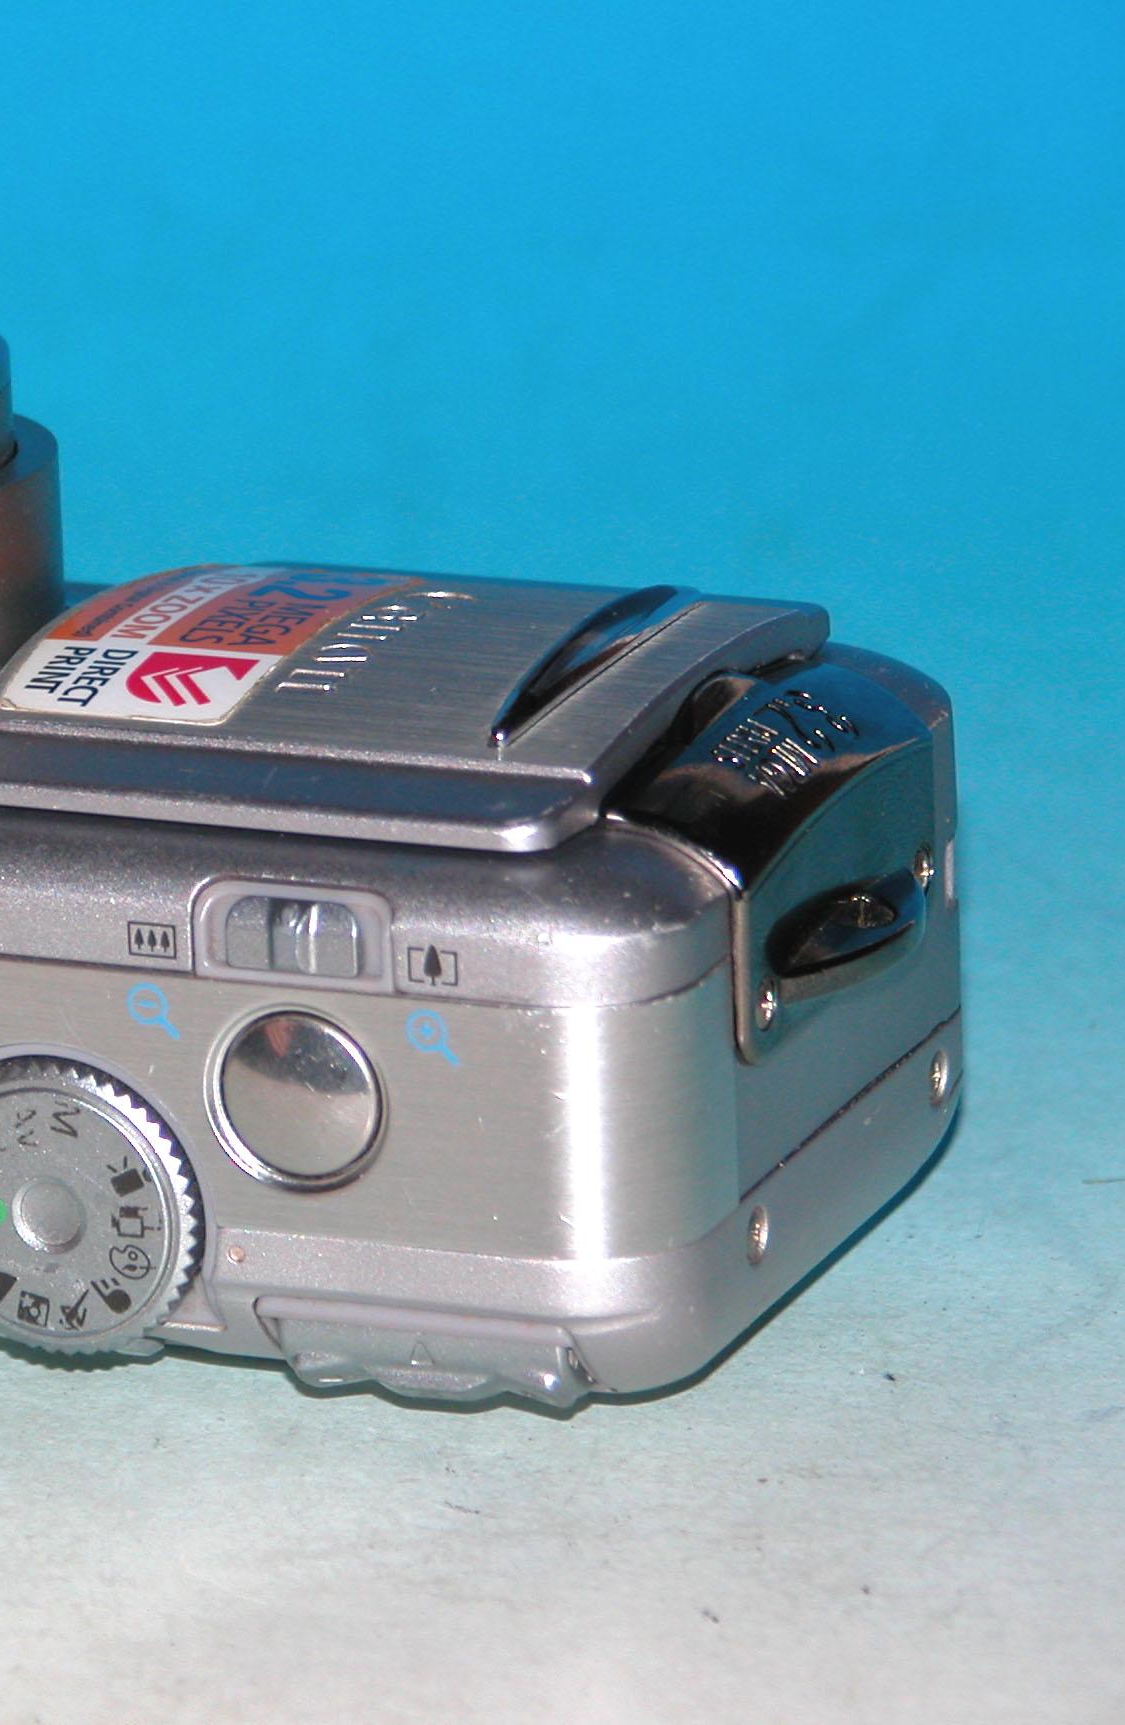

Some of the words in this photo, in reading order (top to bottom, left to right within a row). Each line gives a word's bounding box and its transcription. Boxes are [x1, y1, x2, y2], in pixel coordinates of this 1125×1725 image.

[111, 595, 205, 640] ZOOM
[179, 598, 278, 645] PIXELS
[227, 602, 329, 646] MEGA
[24, 646, 98, 695] PRINT
[57, 648, 139, 707] DIRECT
[50, 1101, 82, 1139] M
